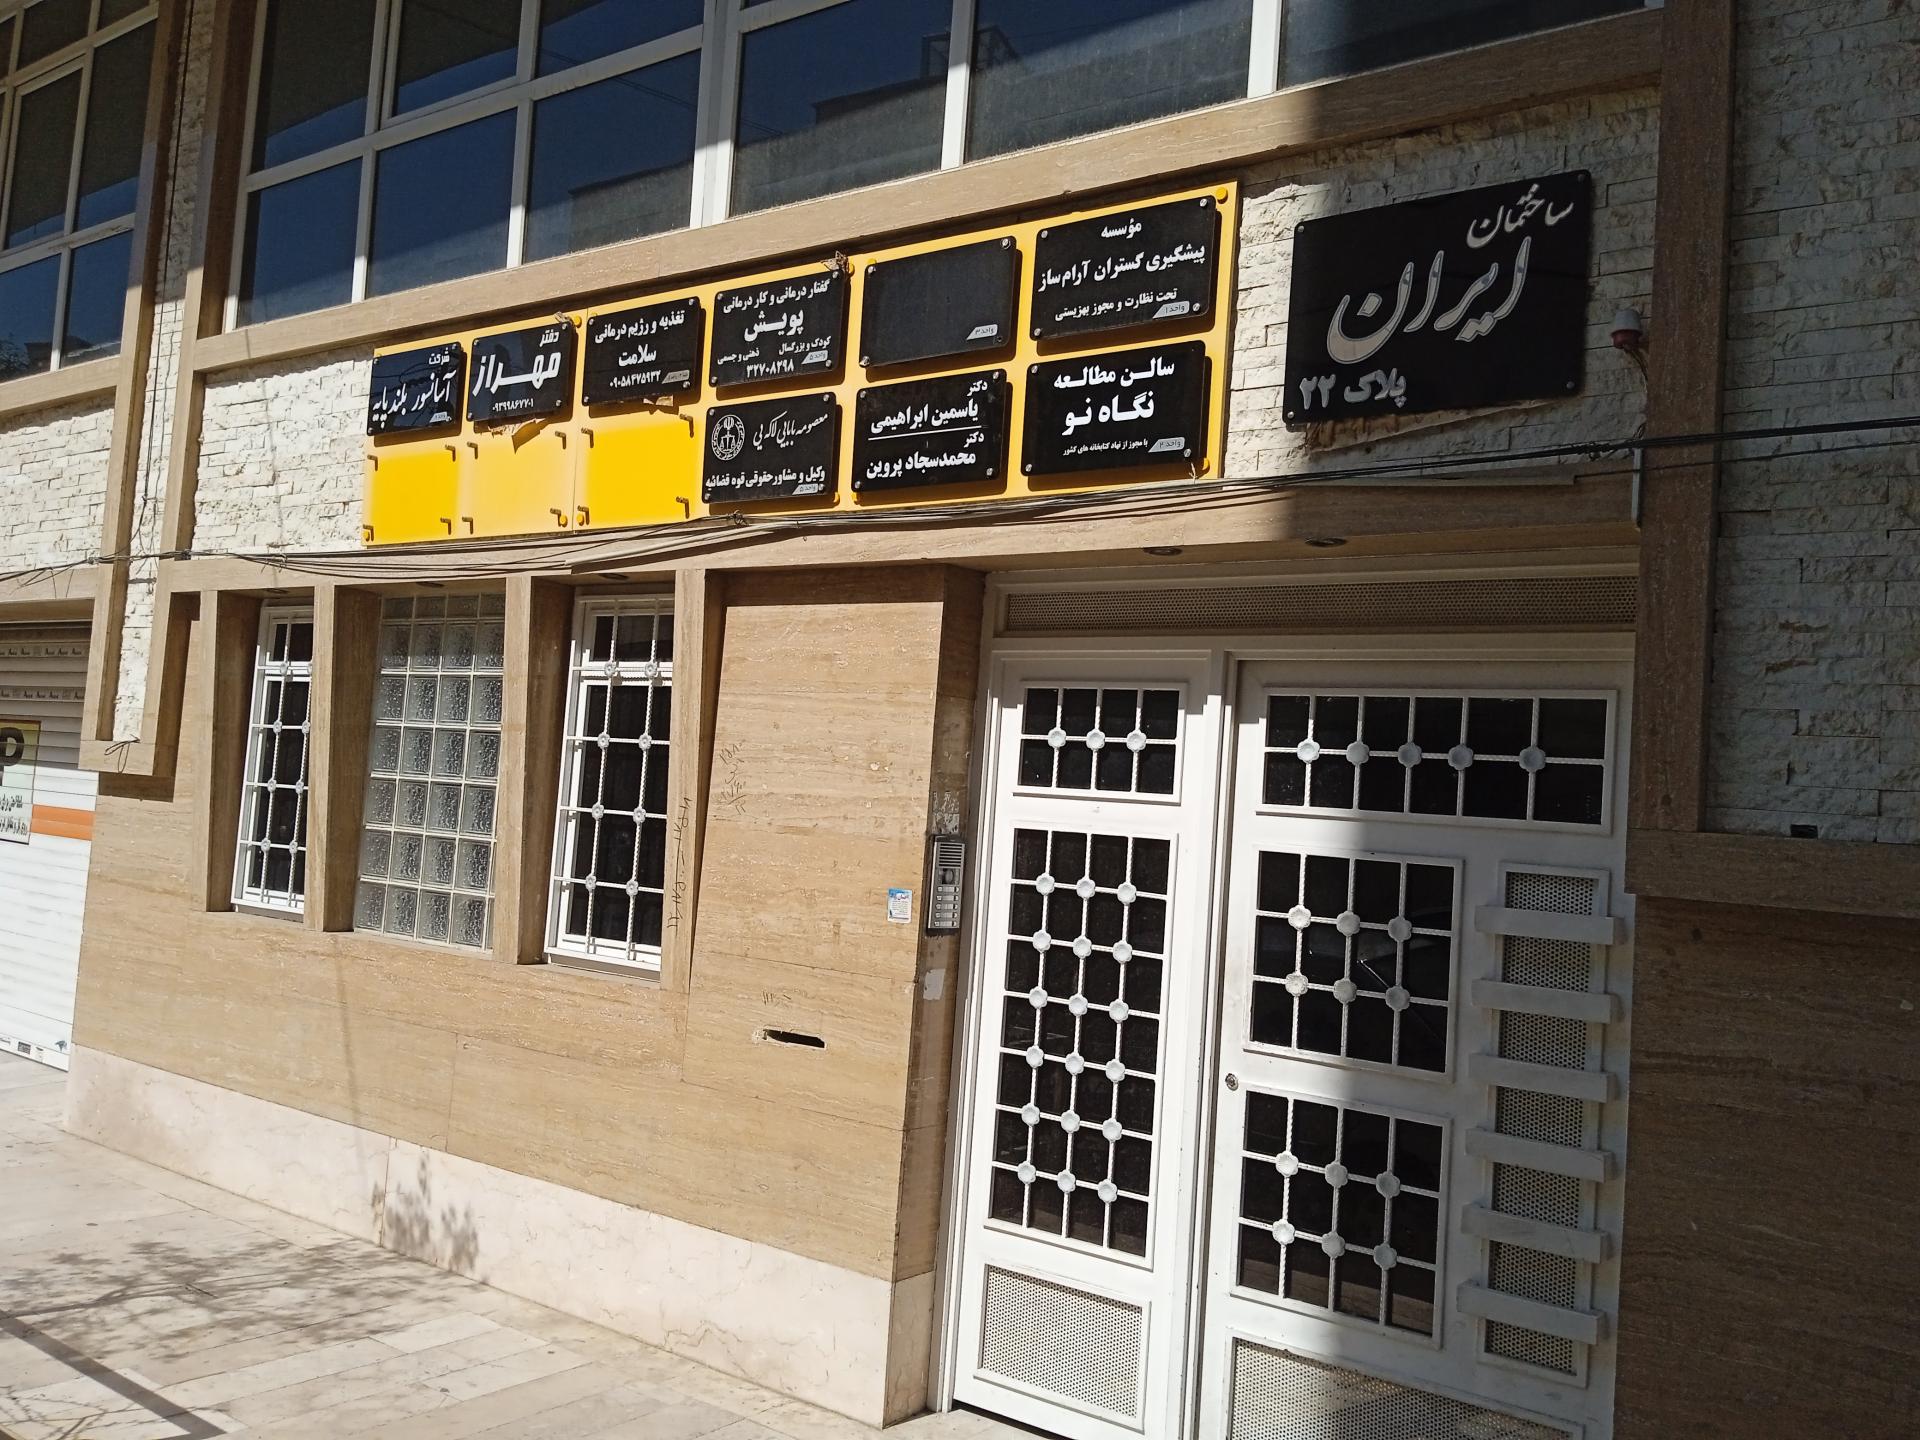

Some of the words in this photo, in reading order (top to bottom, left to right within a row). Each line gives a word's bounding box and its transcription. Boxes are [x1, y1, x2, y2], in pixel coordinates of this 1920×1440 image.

[1466, 183, 1574, 248] ساختمان
[1094, 252, 1144, 281] گستران
[1145, 243, 1206, 272] پیشگیری
[776, 285, 807, 303] درمانی
[808, 279, 830, 298] گفتار
[1156, 288, 1177, 302] تحت
[723, 295, 753, 313] درمانی
[754, 290, 769, 308] کار
[769, 293, 775, 306] و
[1092, 300, 1115, 316] مجوز
[1117, 301, 1123, 311] و
[1124, 292, 1154, 308] نظارت
[1326, 236, 1532, 365] ایران
[659, 309, 685, 330] تغذیه
[1055, 305, 1090, 321] بهزیستی
[595, 323, 627, 344] درمانی
[628, 318, 649, 339] رژیم
[650, 320, 657, 334] و
[744, 309, 804, 341] پویش
[539, 329, 559, 347] دفتر
[811, 335, 832, 349] کودک
[428, 347, 450, 365] شرکت
[618, 344, 657, 366] سلامت
[778, 342, 805, 355] بزرگسال
[717, 354, 737, 365] جسمی
[1053, 366, 1116, 389] مطالعه
[1120, 356, 1175, 387] سالن
[411, 370, 456, 411] آسانسور
[967, 380, 988, 397] دکتر
[1299, 374, 1336, 410] ۲۲
[1343, 367, 1407, 408] پلاک
[931, 399, 979, 427] یاسمین
[1098, 391, 1155, 423] نگاه
[796, 413, 828, 434] معصومه
[870, 404, 929, 434] ابراهیمی
[1062, 397, 1092, 436] نو
[964, 431, 985, 448] دکتر
[1121, 440, 1128, 450] از
[1129, 440, 1142, 449] مجوز
[1063, 445, 1077, 456] کشور
[772, 468, 797, 485] مشاور
[805, 466, 826, 482] وکیل
[866, 456, 903, 479] پروین
[731, 472, 745, 489] قوه
[745, 471, 773, 487] حقوقی
[797, 472, 803, 483] و
